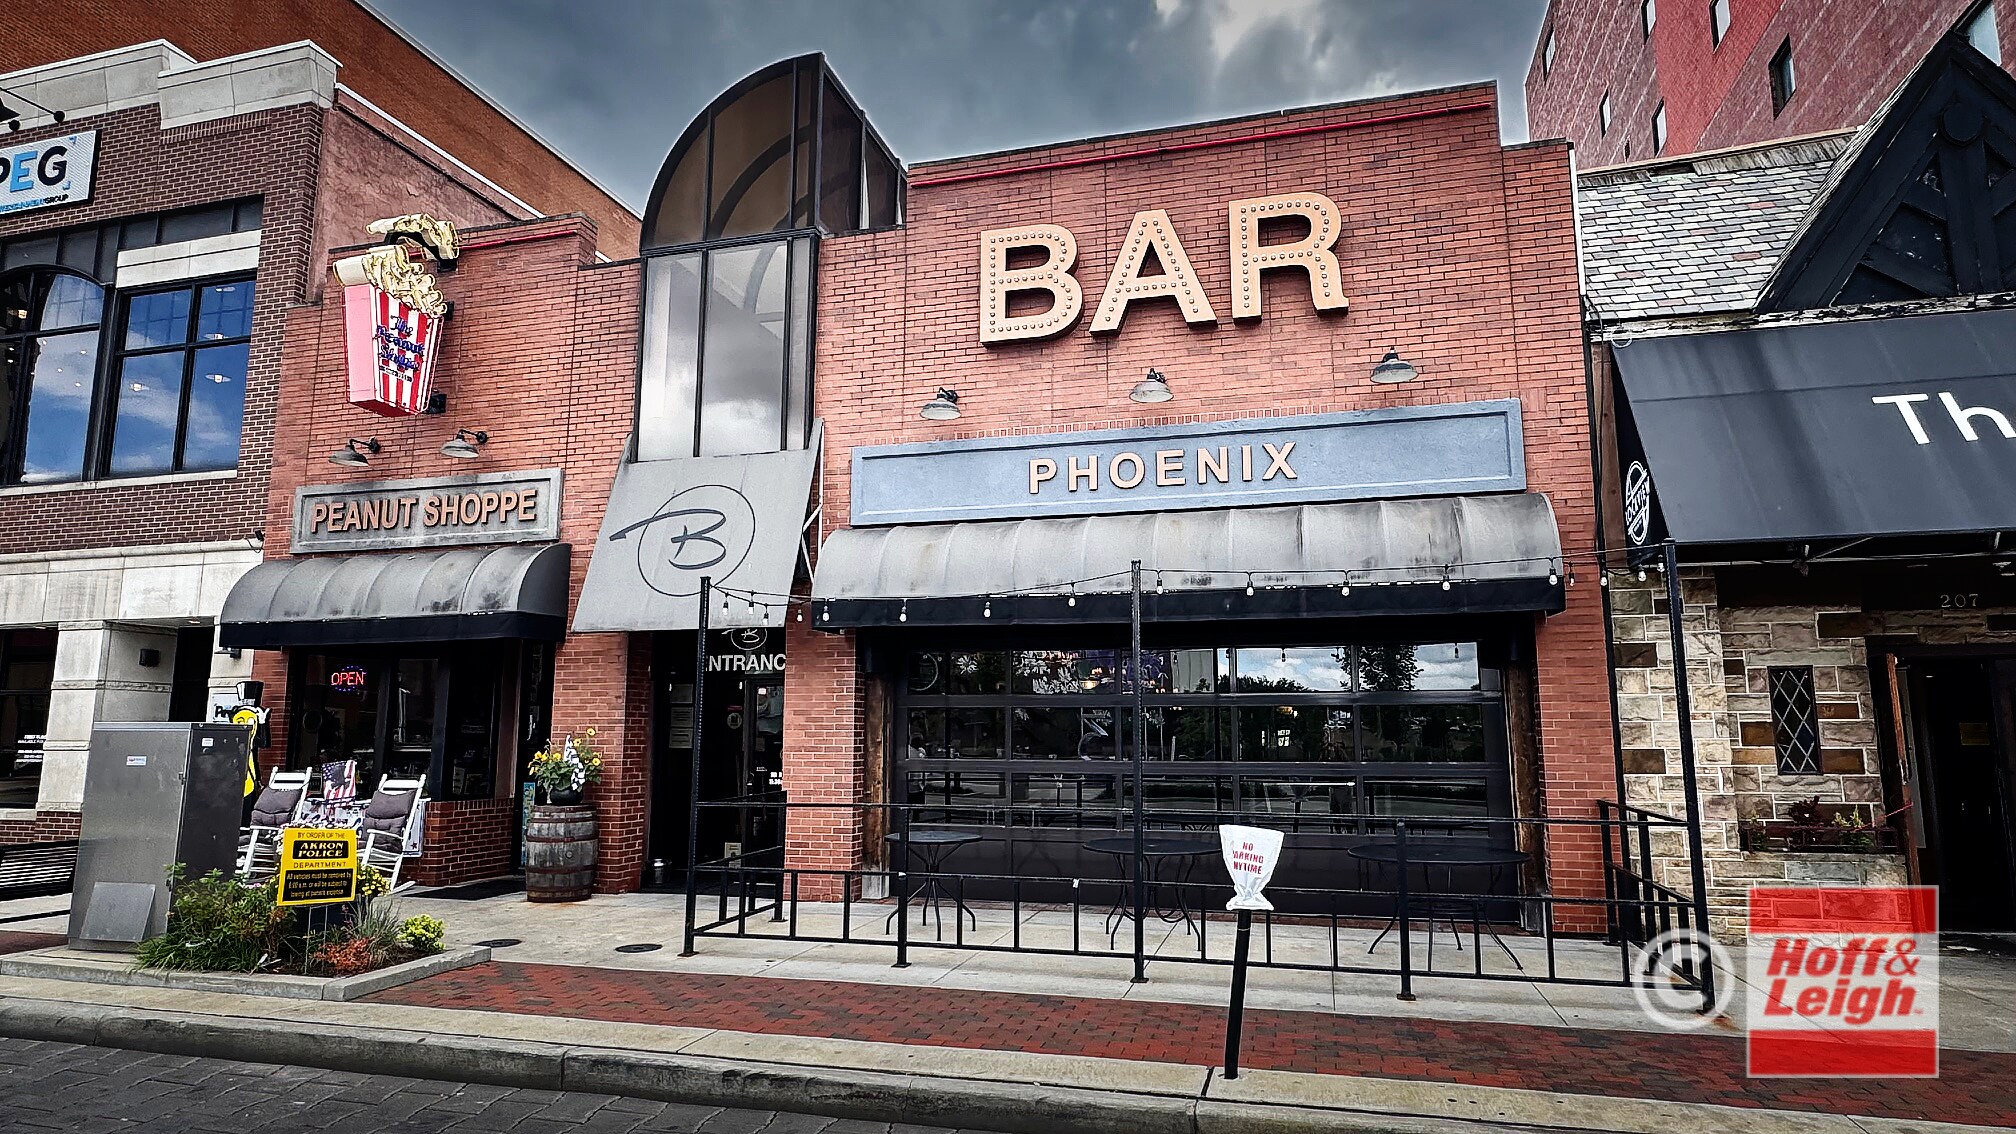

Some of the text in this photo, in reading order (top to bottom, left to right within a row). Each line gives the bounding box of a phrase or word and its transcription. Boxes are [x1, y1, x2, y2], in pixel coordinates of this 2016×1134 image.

[980, 192, 1350, 347] BAR
[1028, 441, 1298, 494] PHOENIX
[310, 489, 538, 533] PEANUT SHOPPE
[1940, 593, 1979, 608] 207
[705, 653, 786, 672] NTRANC
[331, 671, 365, 686] OPEN
[300, 842, 344, 850] AKRON
[1242, 842, 1254, 851] NO
[298, 850, 343, 858] POLICE
[1233, 850, 1264, 864] ARKING
[1234, 861, 1262, 874] NYTIME
